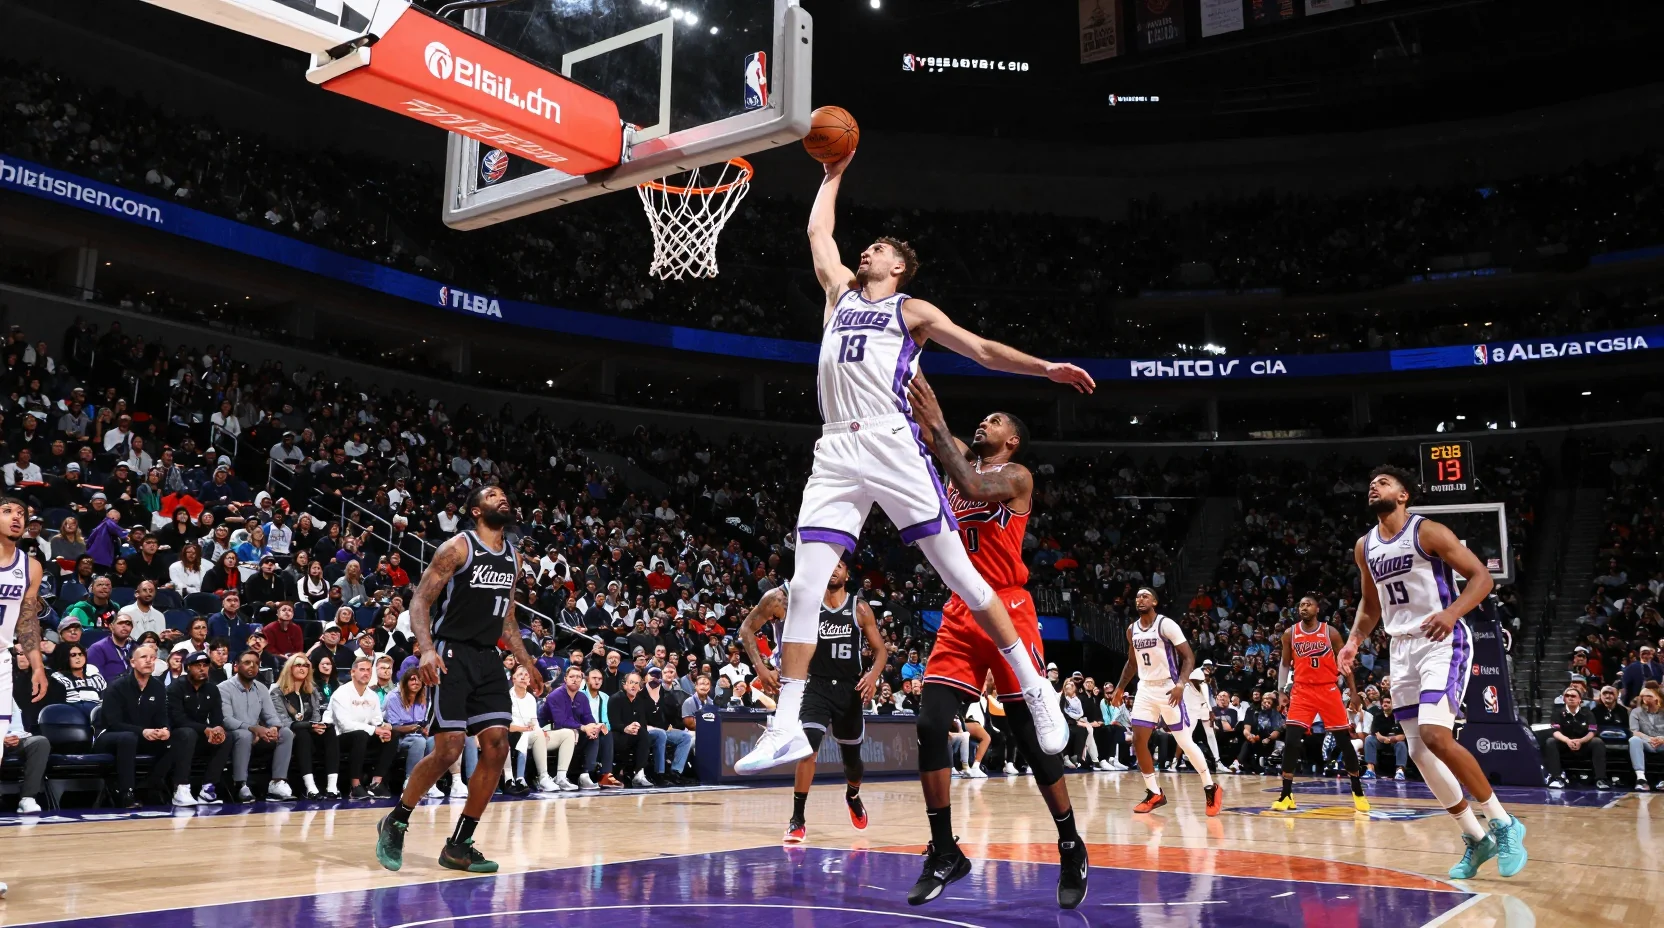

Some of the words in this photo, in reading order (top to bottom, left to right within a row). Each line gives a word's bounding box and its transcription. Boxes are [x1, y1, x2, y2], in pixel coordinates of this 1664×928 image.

[838, 334, 867, 363] 13
[1385, 581, 1409, 605] 19
[493, 596, 509, 617] 11
[831, 643, 852, 659] 16
